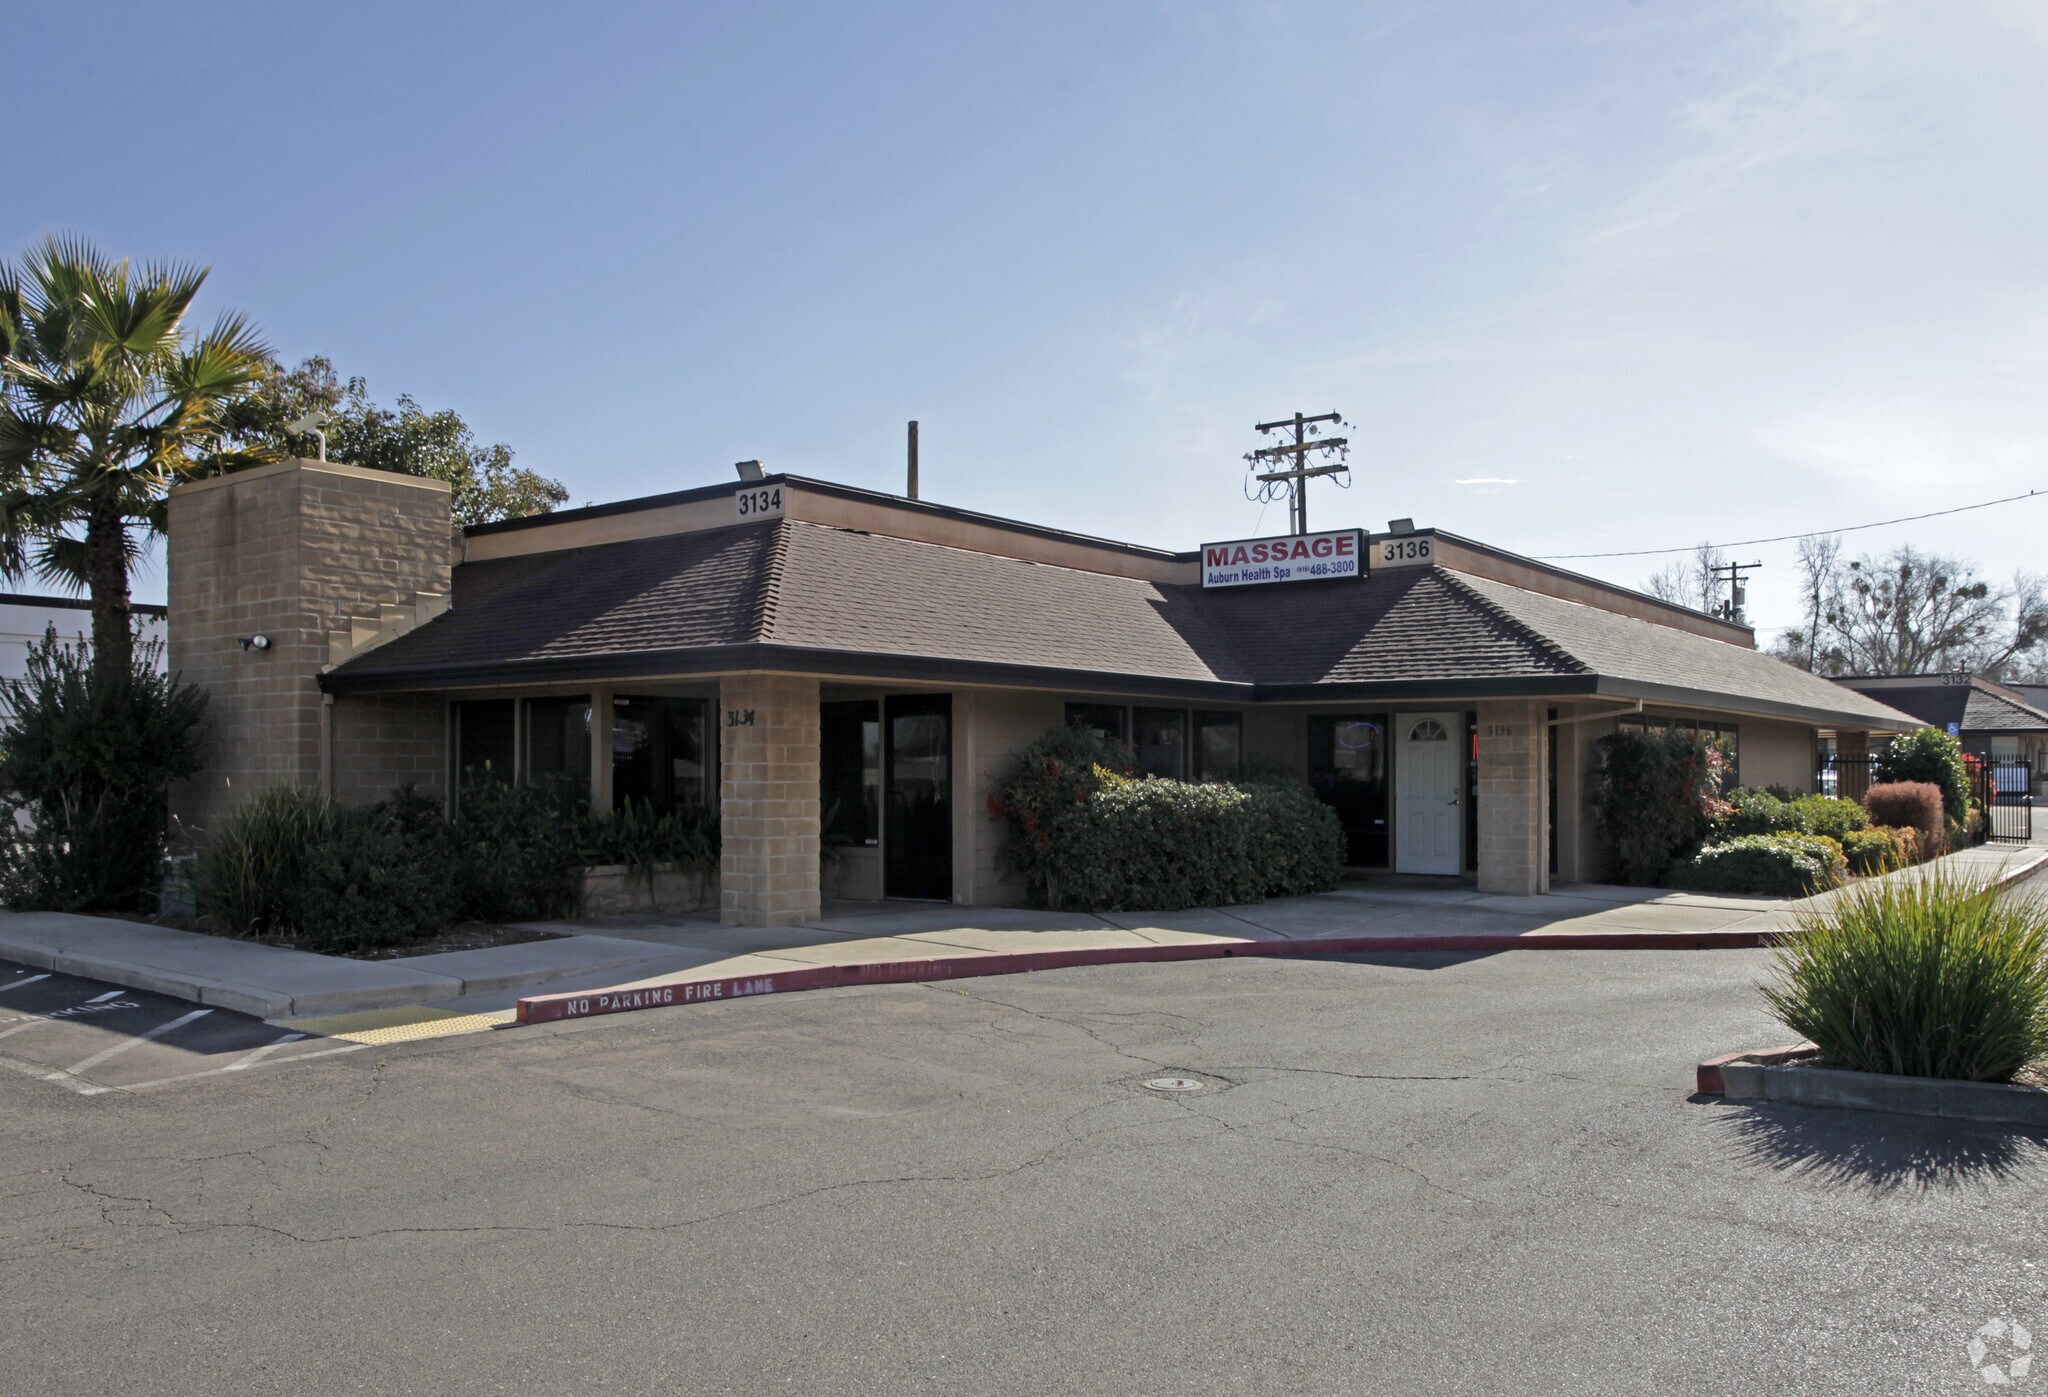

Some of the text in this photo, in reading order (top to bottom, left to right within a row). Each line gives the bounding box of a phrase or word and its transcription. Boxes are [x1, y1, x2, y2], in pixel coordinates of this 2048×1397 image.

[739, 488, 782, 515] 3134
[1207, 536, 1355, 568] MASSAGE
[1384, 540, 1430, 562] 3136
[1208, 569, 1240, 585] Auburn
[1241, 567, 1271, 582] Health
[1273, 566, 1291, 582] Spa
[1942, 675, 1971, 685] 3132
[1488, 724, 1512, 737] 3136
[567, 978, 774, 1015] NO PARKING FIRE LANE
